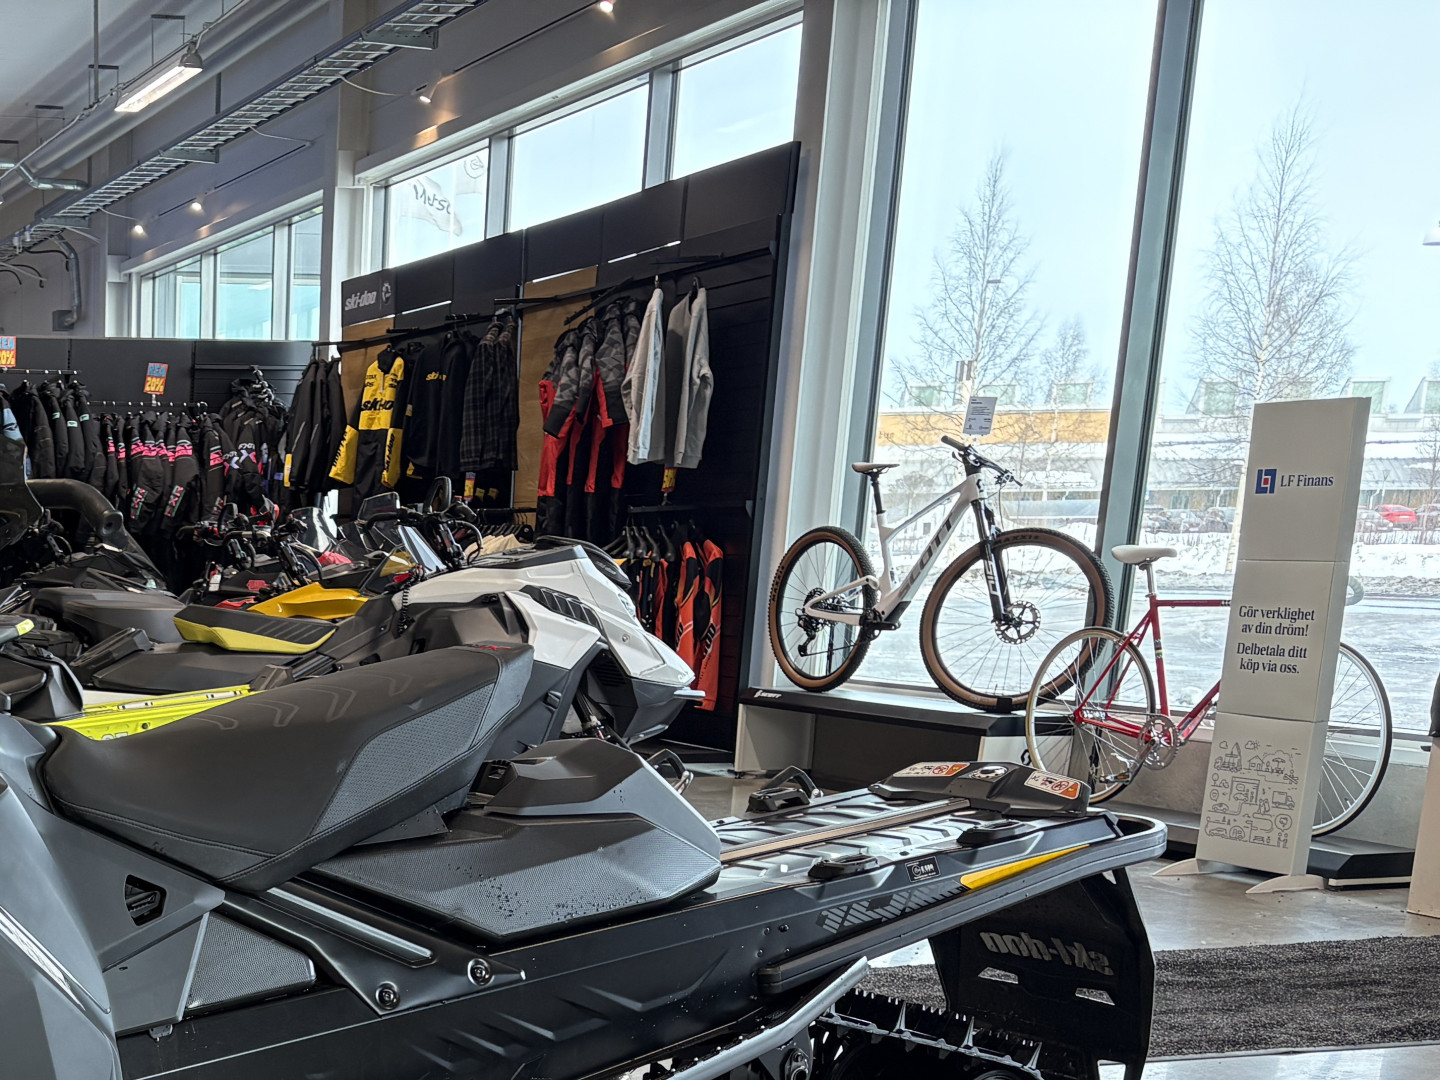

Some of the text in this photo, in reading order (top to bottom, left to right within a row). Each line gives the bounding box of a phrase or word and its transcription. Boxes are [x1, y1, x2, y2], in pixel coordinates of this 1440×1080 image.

[345, 290, 377, 310] ski-doo
[148, 364, 166, 377] REA
[145, 377, 165, 392] 20%
[1280, 474, 1334, 487] LF Finans
[1239, 605, 1315, 623] Gör verklighet
[1241, 622, 1309, 637] av din dröm!
[1236, 642, 1308, 659] Delbetala ditt
[1239, 658, 1300, 674] köp via oss.
